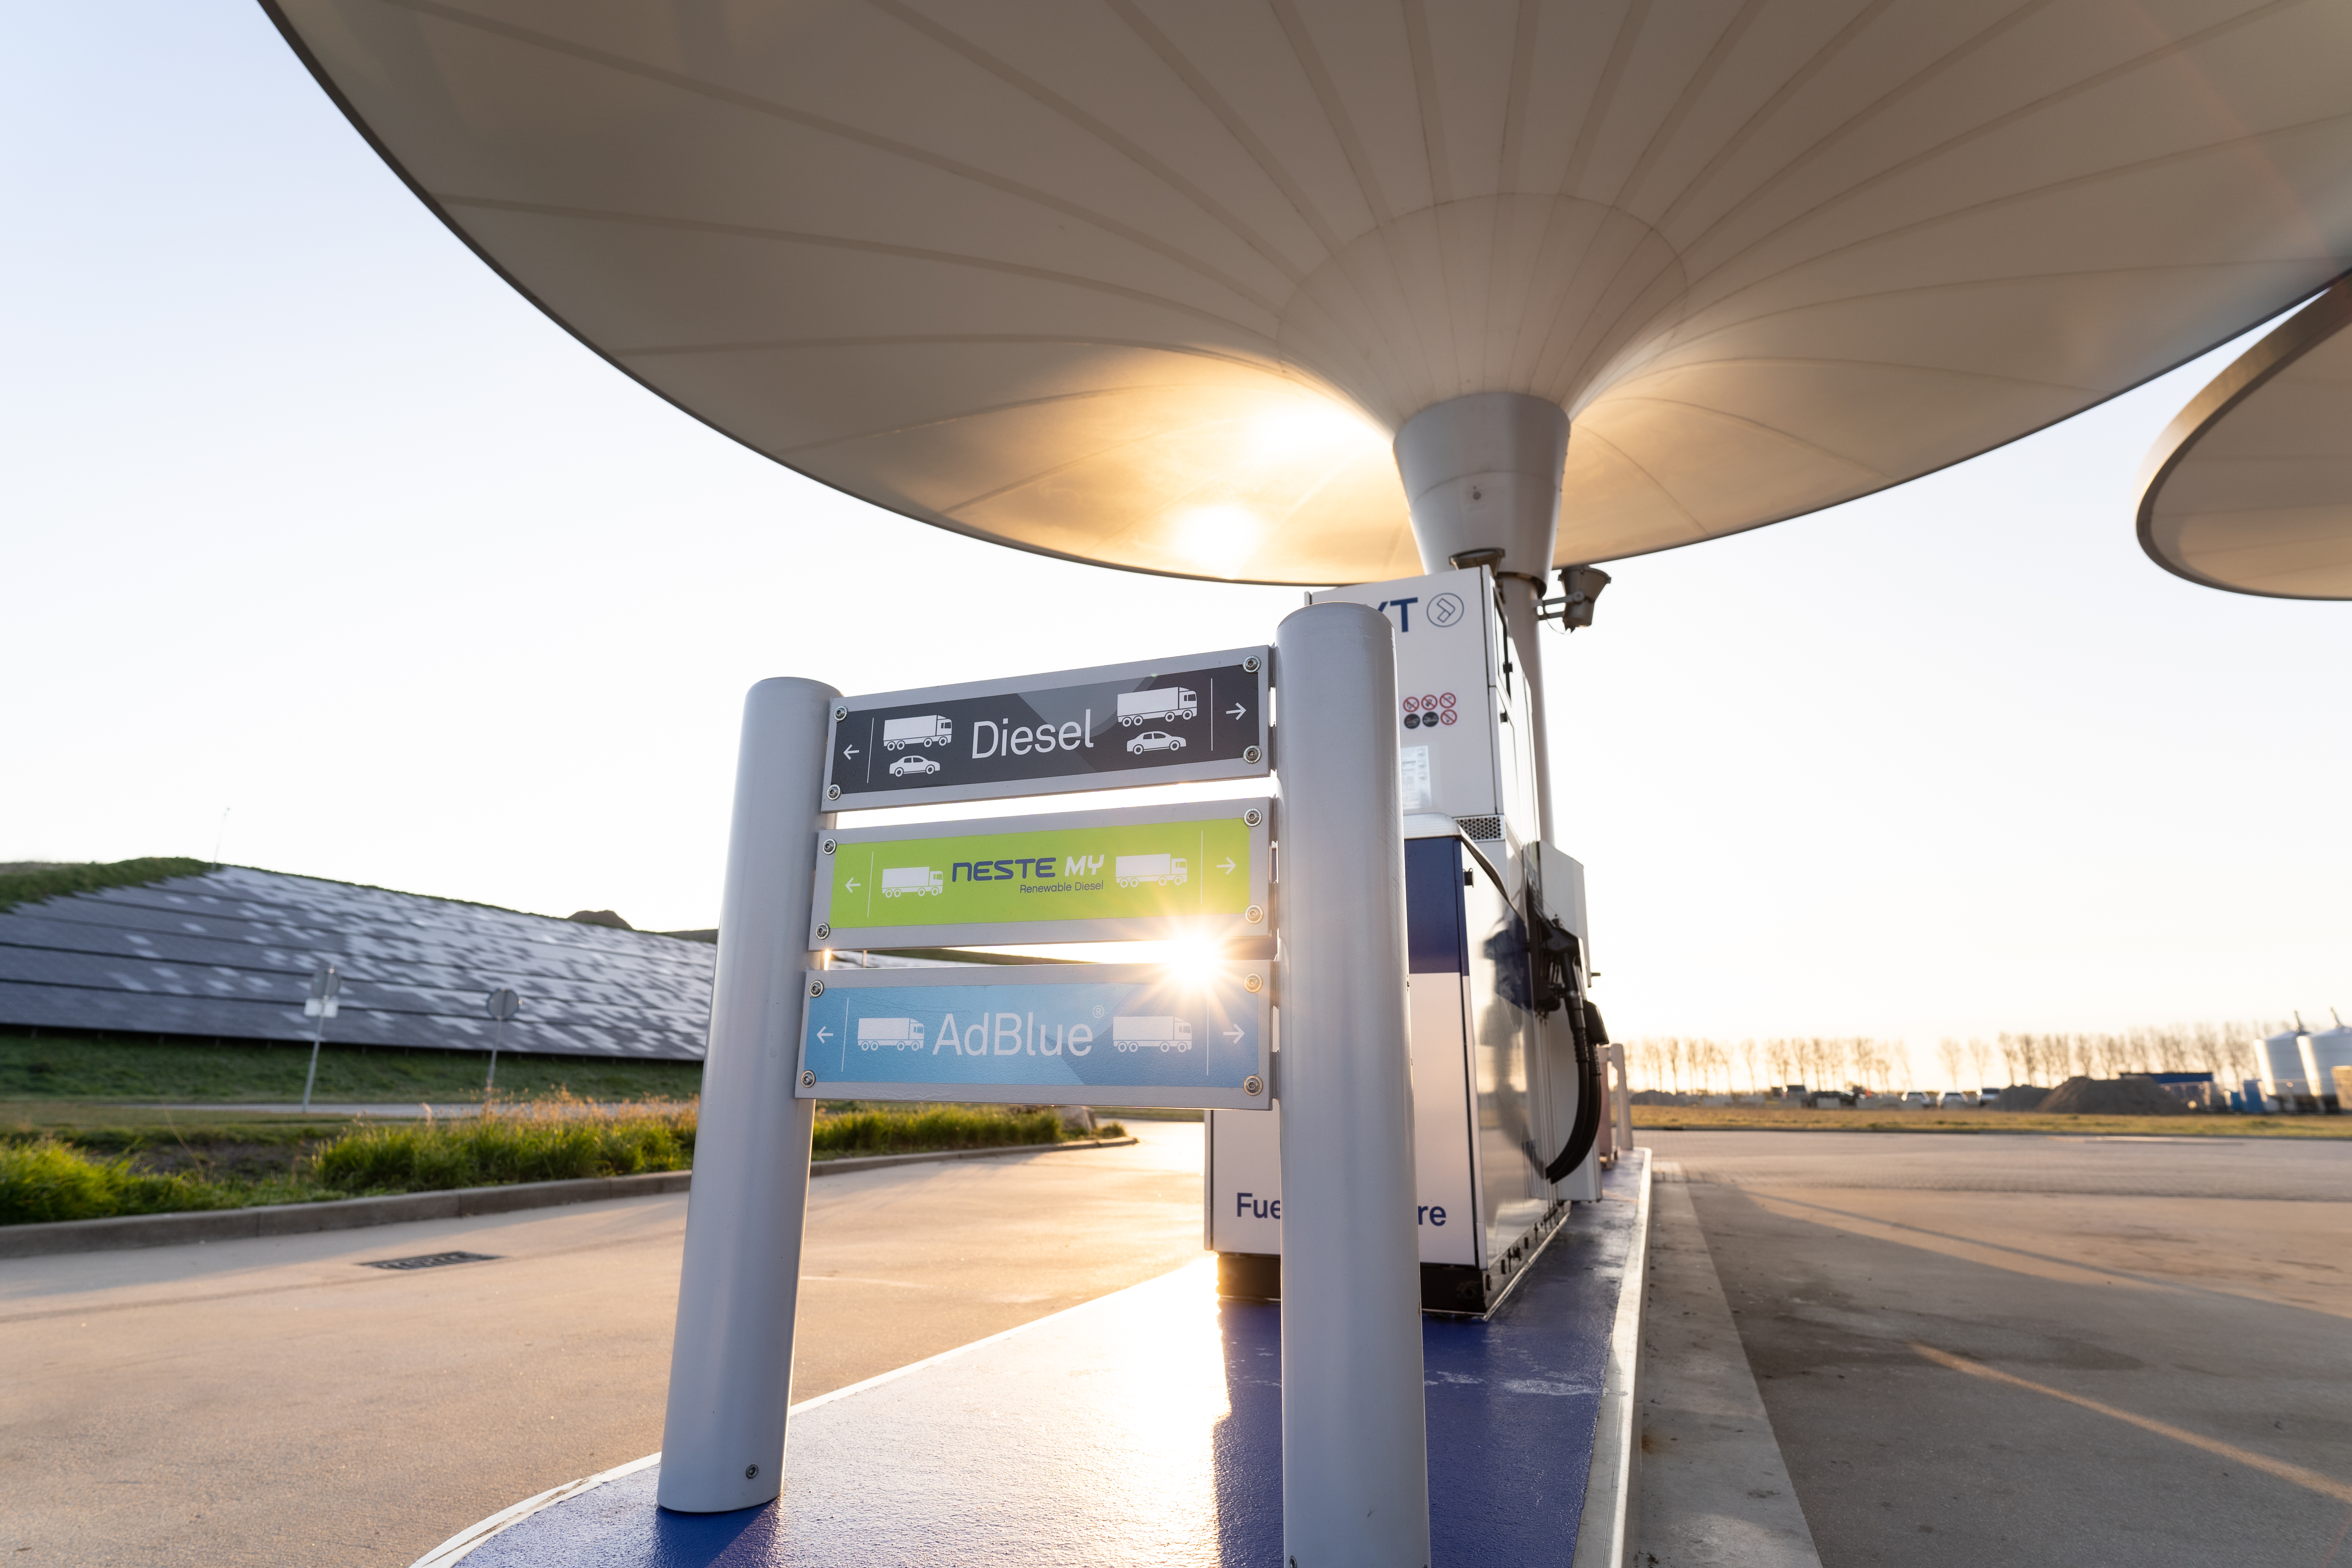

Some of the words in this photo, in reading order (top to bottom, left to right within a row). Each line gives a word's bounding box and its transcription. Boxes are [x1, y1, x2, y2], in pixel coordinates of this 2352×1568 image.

[972, 709, 1094, 759] Diesel
[952, 857, 1056, 882] NESTE
[1065, 855, 1105, 877] MY
[1020, 882, 1072, 893] Renewable
[1075, 880, 1103, 891] Diesel
[1237, 1192, 1281, 1219] Fue
